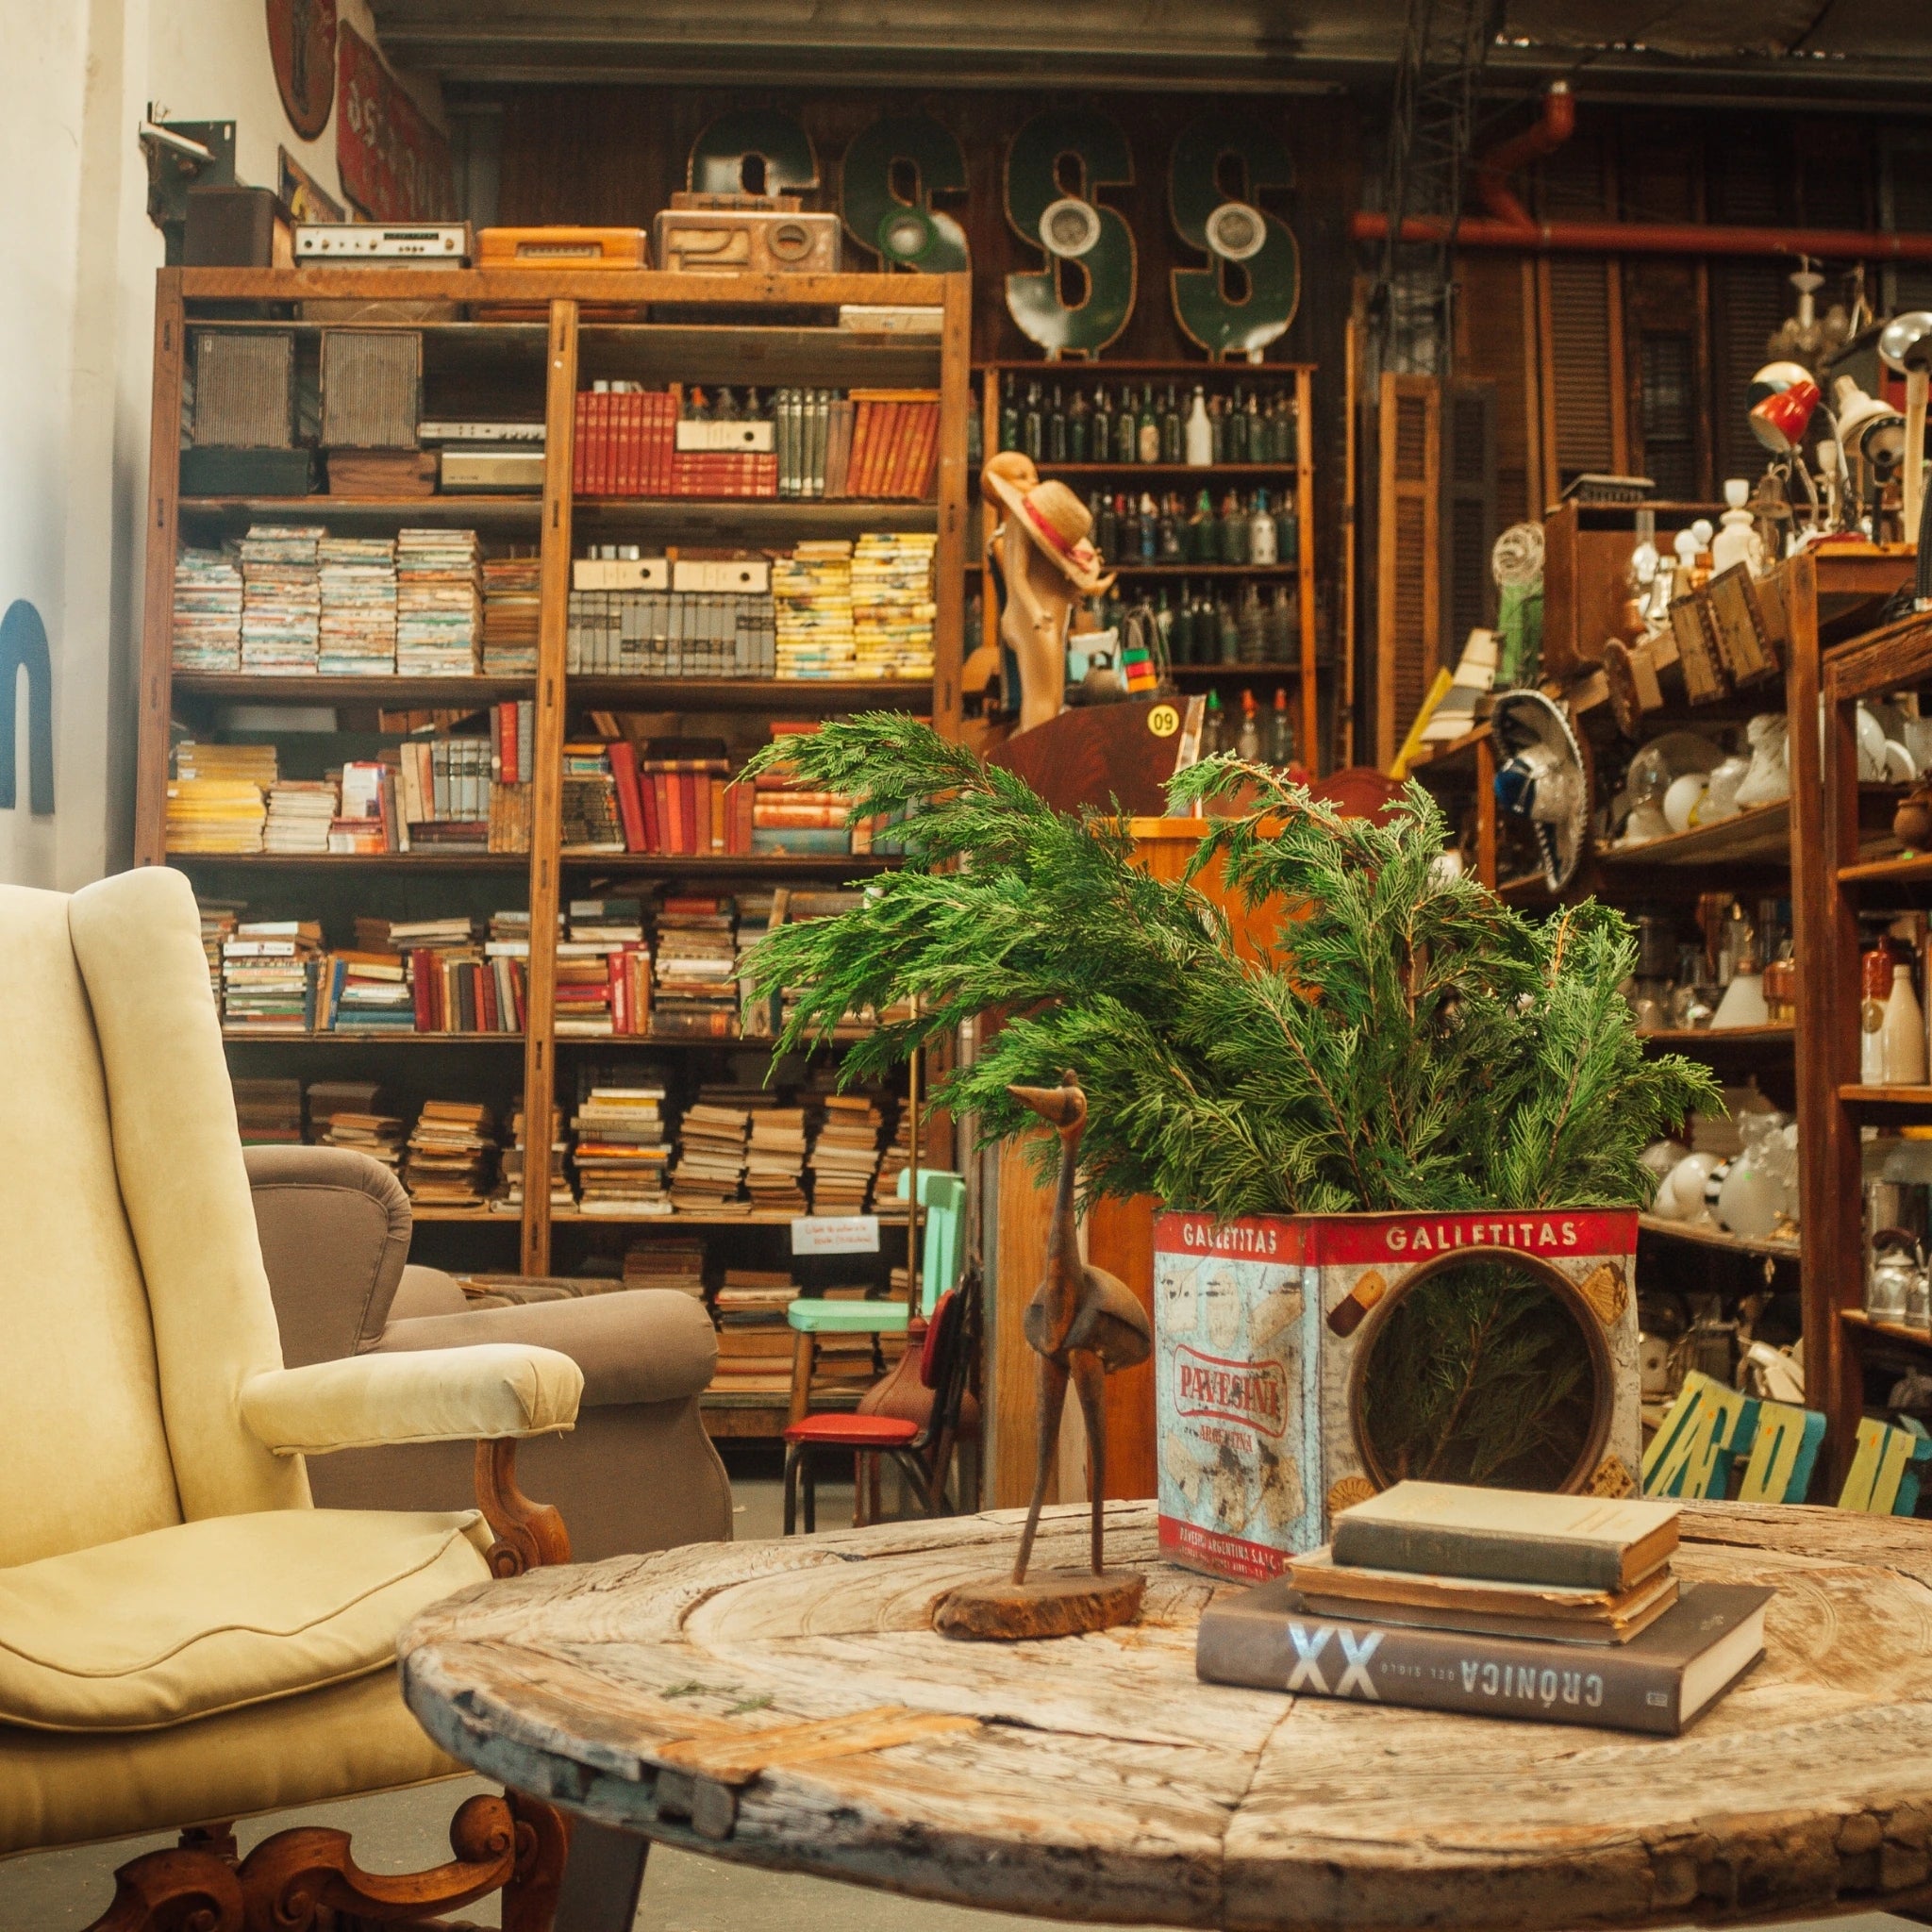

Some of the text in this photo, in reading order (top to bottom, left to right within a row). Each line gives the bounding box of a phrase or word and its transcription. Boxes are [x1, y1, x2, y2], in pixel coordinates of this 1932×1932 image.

[1154, 712, 1174, 731] 09
[1183, 1223, 1277, 1255] GALLETITAS
[1386, 1222, 1577, 1251] GALLETITAS
[1180, 1364, 1279, 1417] PAVESINI
[1287, 1620, 1603, 1708] CRÓNICA DEL SIGLO XX
